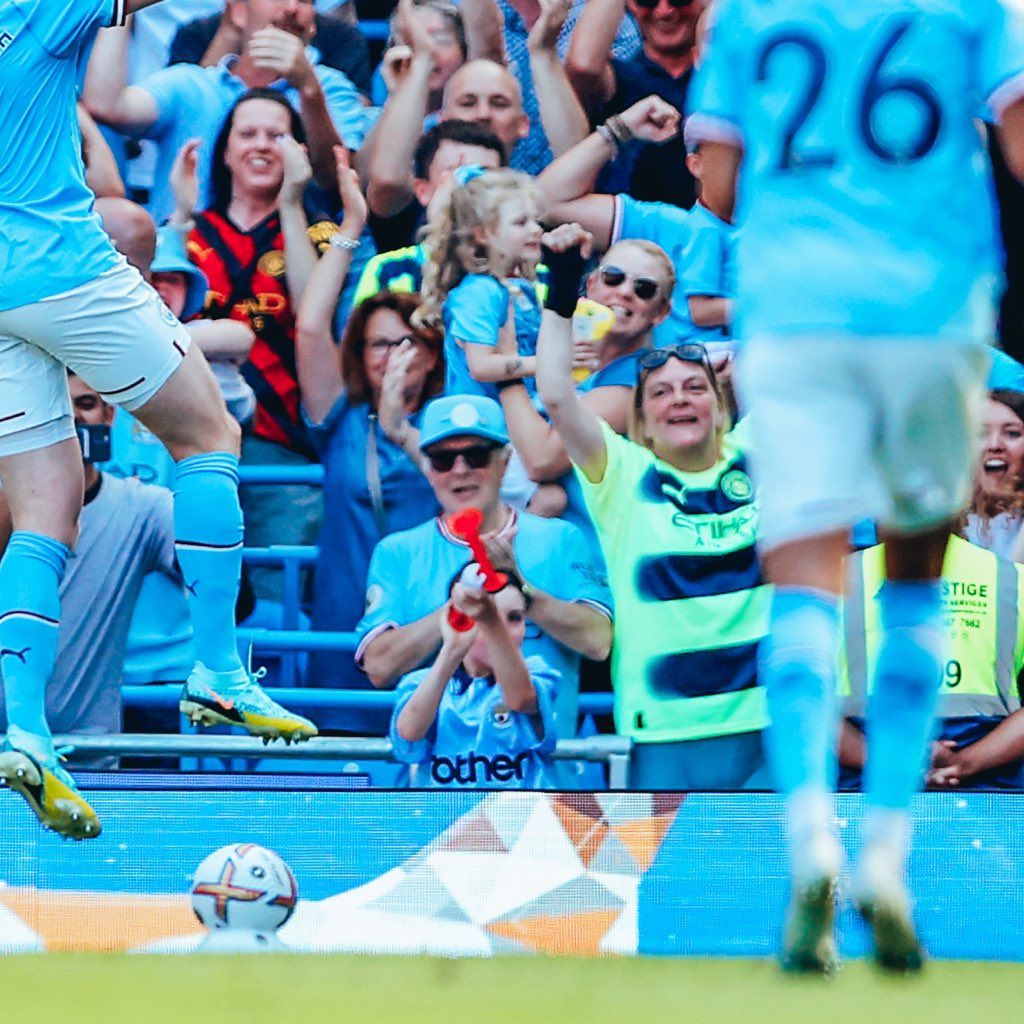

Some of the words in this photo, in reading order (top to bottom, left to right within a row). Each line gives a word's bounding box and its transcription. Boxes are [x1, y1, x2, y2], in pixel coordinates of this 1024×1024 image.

[755, 19, 943, 171] 26
[943, 659, 962, 688] 9
[431, 750, 532, 785] other
